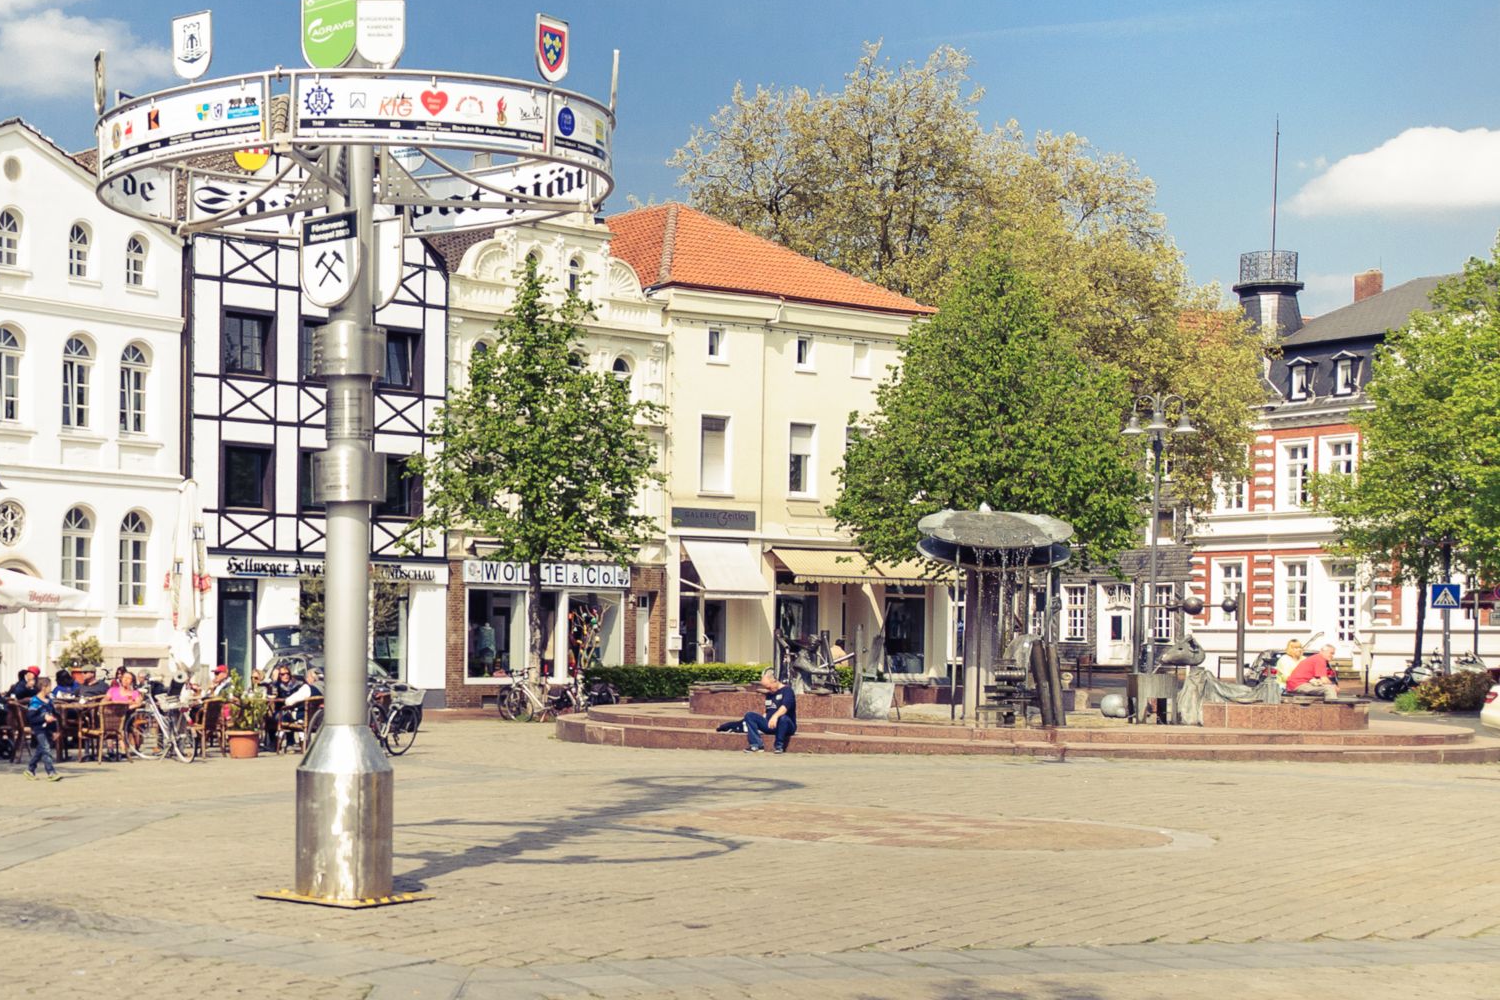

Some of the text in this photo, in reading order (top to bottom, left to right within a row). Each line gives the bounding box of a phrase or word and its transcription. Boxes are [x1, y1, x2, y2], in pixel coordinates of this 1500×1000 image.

[312, 19, 355, 37] AGRAVIS
[684, 511, 717, 519] GALERIE
[227, 556, 289, 577] Hellweger
[572, 572, 579, 583] &
[586, 567, 613, 584] Co.
